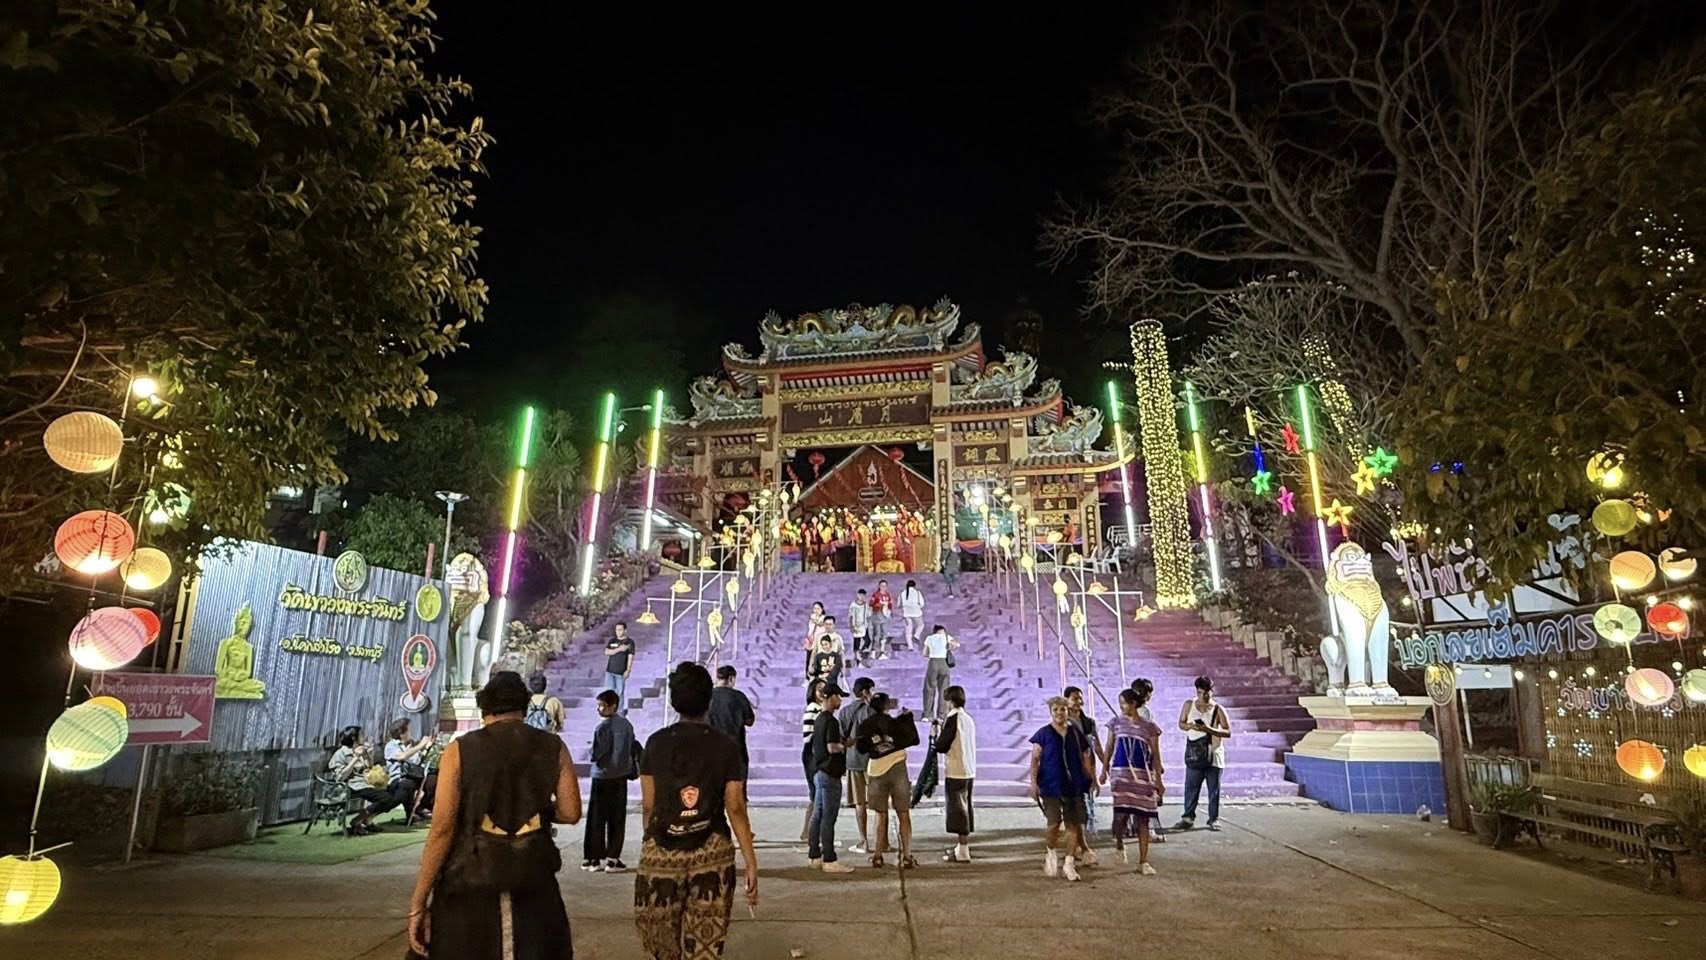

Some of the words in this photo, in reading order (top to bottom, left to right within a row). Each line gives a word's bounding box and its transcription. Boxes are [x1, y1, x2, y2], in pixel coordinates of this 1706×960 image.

[279, 582, 407, 621] วัดเขาวงพระจันทร์
[166, 696, 183, 717] ขั้น
